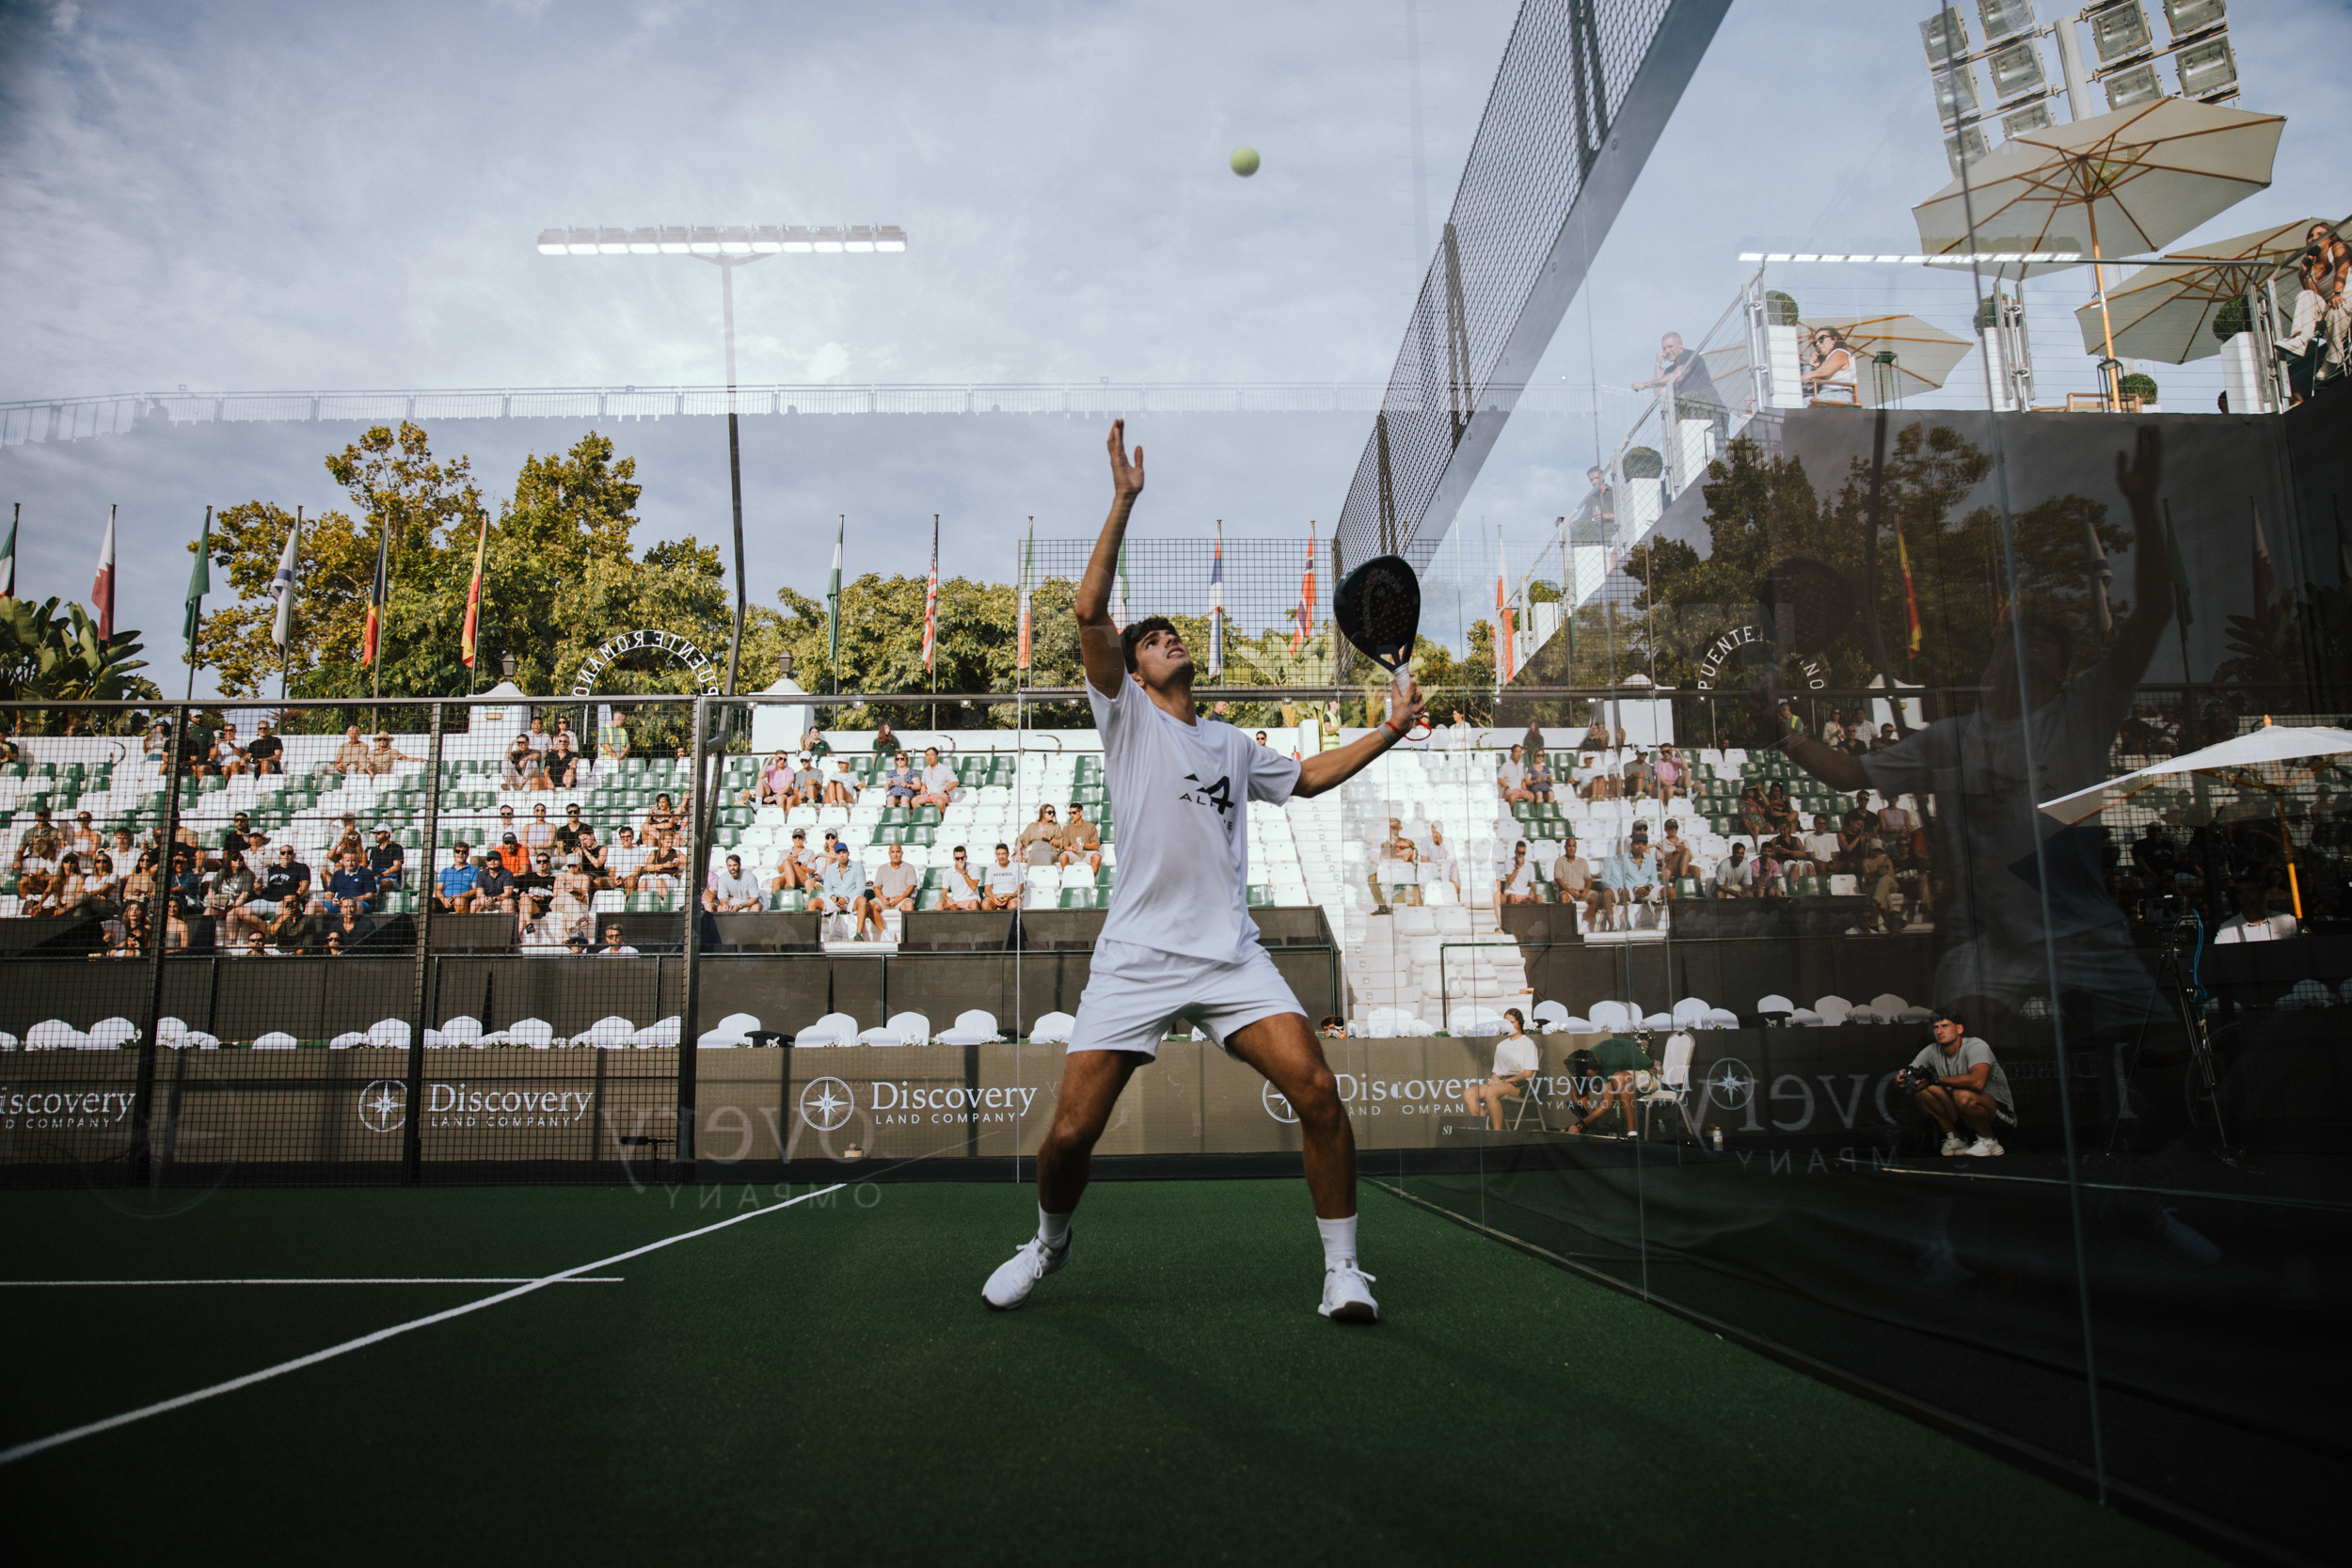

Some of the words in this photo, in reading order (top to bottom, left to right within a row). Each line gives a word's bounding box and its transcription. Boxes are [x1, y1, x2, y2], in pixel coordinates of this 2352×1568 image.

[1697, 626, 1756, 690] PUENTE
[0, 1085, 136, 1122] iscovery
[427, 1083, 594, 1121] Discovery
[870, 1081, 1038, 1117] Discovery
[1348, 1105, 1381, 1117] AND
[1401, 1103, 1465, 1117] OMPAN
[25, 1117, 110, 1129] COMPANY
[431, 1116, 476, 1127] LAND
[485, 1116, 570, 1127] COMPANY
[875, 1114, 921, 1125] LAND
[930, 1112, 1016, 1124] COMPANY
